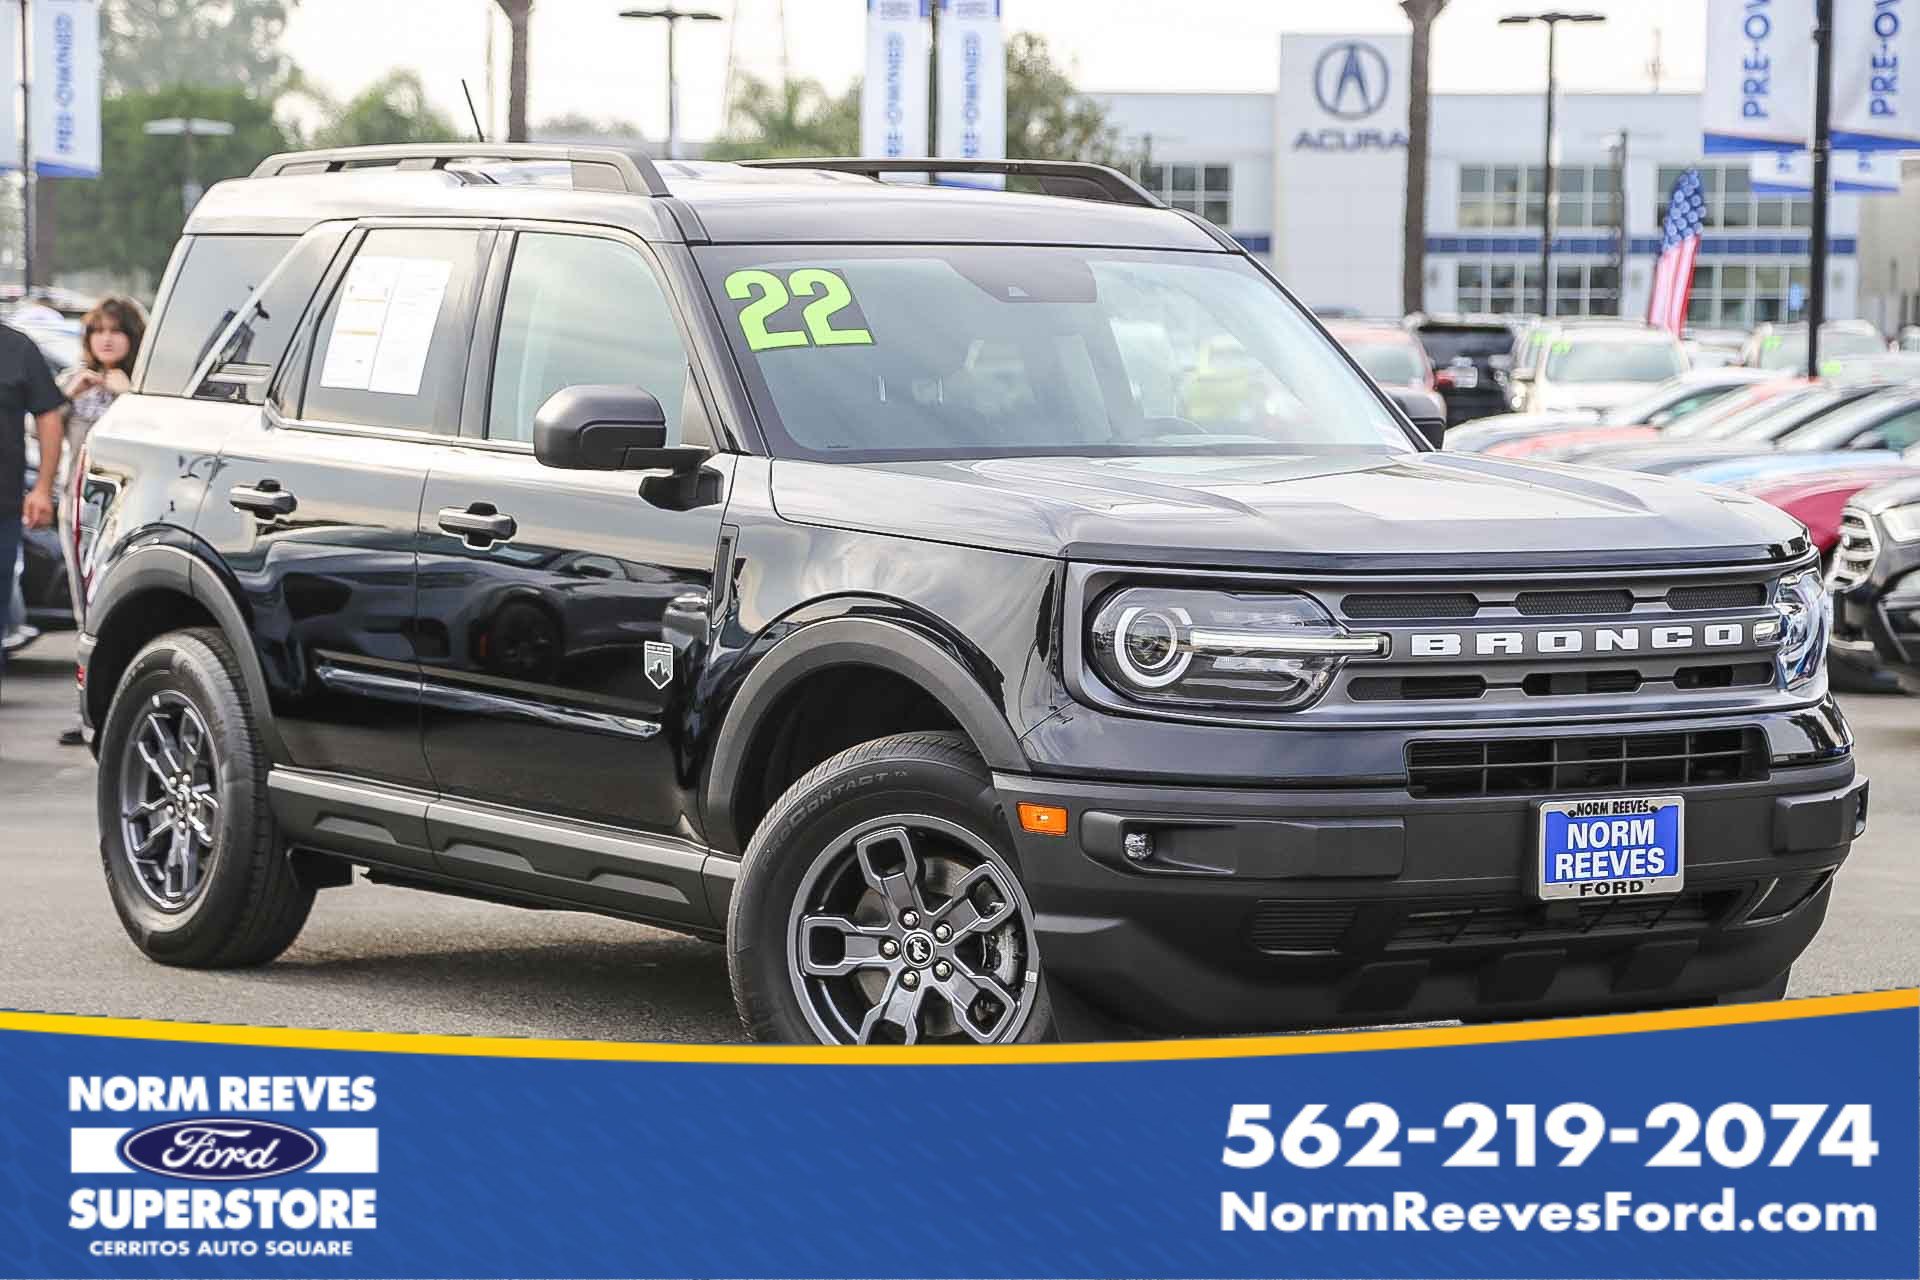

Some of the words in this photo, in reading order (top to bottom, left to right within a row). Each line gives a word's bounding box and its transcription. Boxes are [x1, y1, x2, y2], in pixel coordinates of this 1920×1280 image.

[1743, 0, 1769, 118] PRE-O
[887, 33, 902, 157] RE-OWNED
[964, 33, 979, 157] RE-OWNED
[1294, 129, 1408, 151] ACURA
[724, 268, 877, 352] 22
[1410, 623, 1743, 657] BRONCO
[1576, 802, 1609, 816] NORM
[1612, 800, 1649, 814] REEVES
[1567, 819, 1656, 849] NORM
[1555, 847, 1665, 880] REEVES
[1580, 880, 1644, 896] FORD
